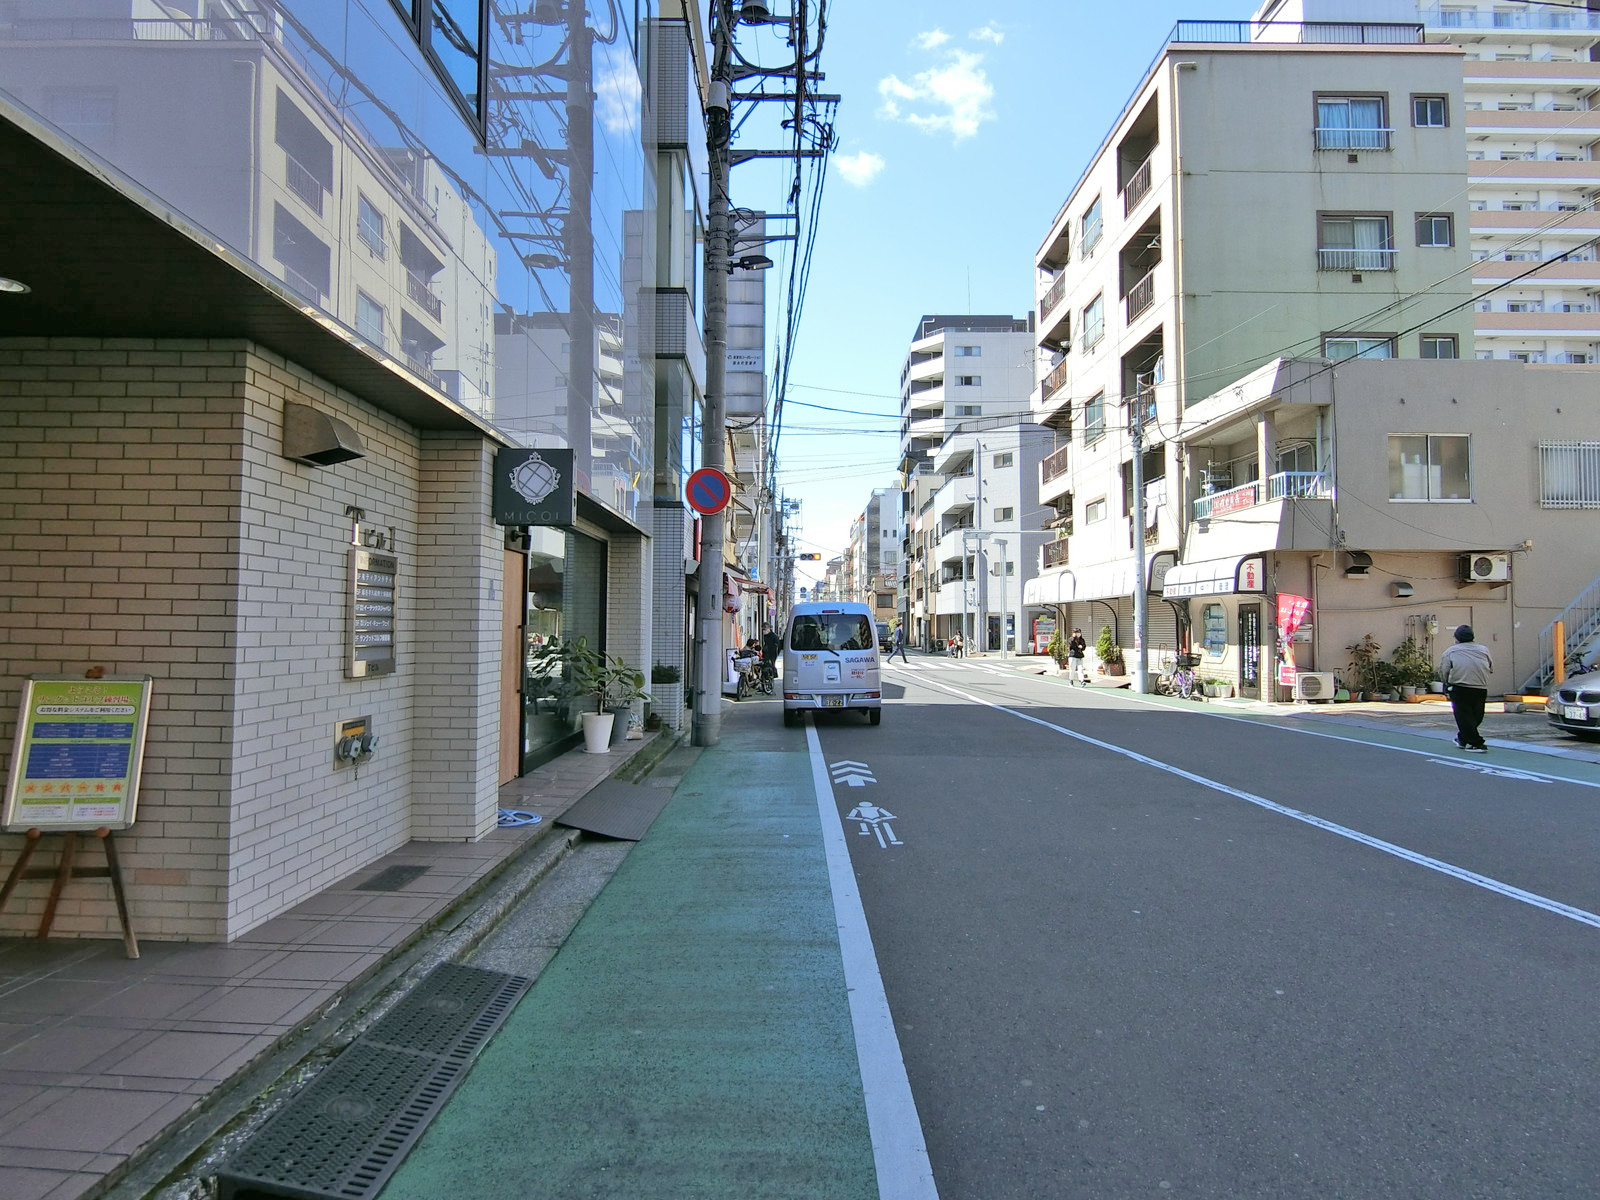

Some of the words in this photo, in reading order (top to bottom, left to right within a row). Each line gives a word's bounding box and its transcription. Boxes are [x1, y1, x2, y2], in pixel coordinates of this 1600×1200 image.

[1246, 563, 1255, 588] 不動産
[845, 656, 875, 664] SAGAWA
